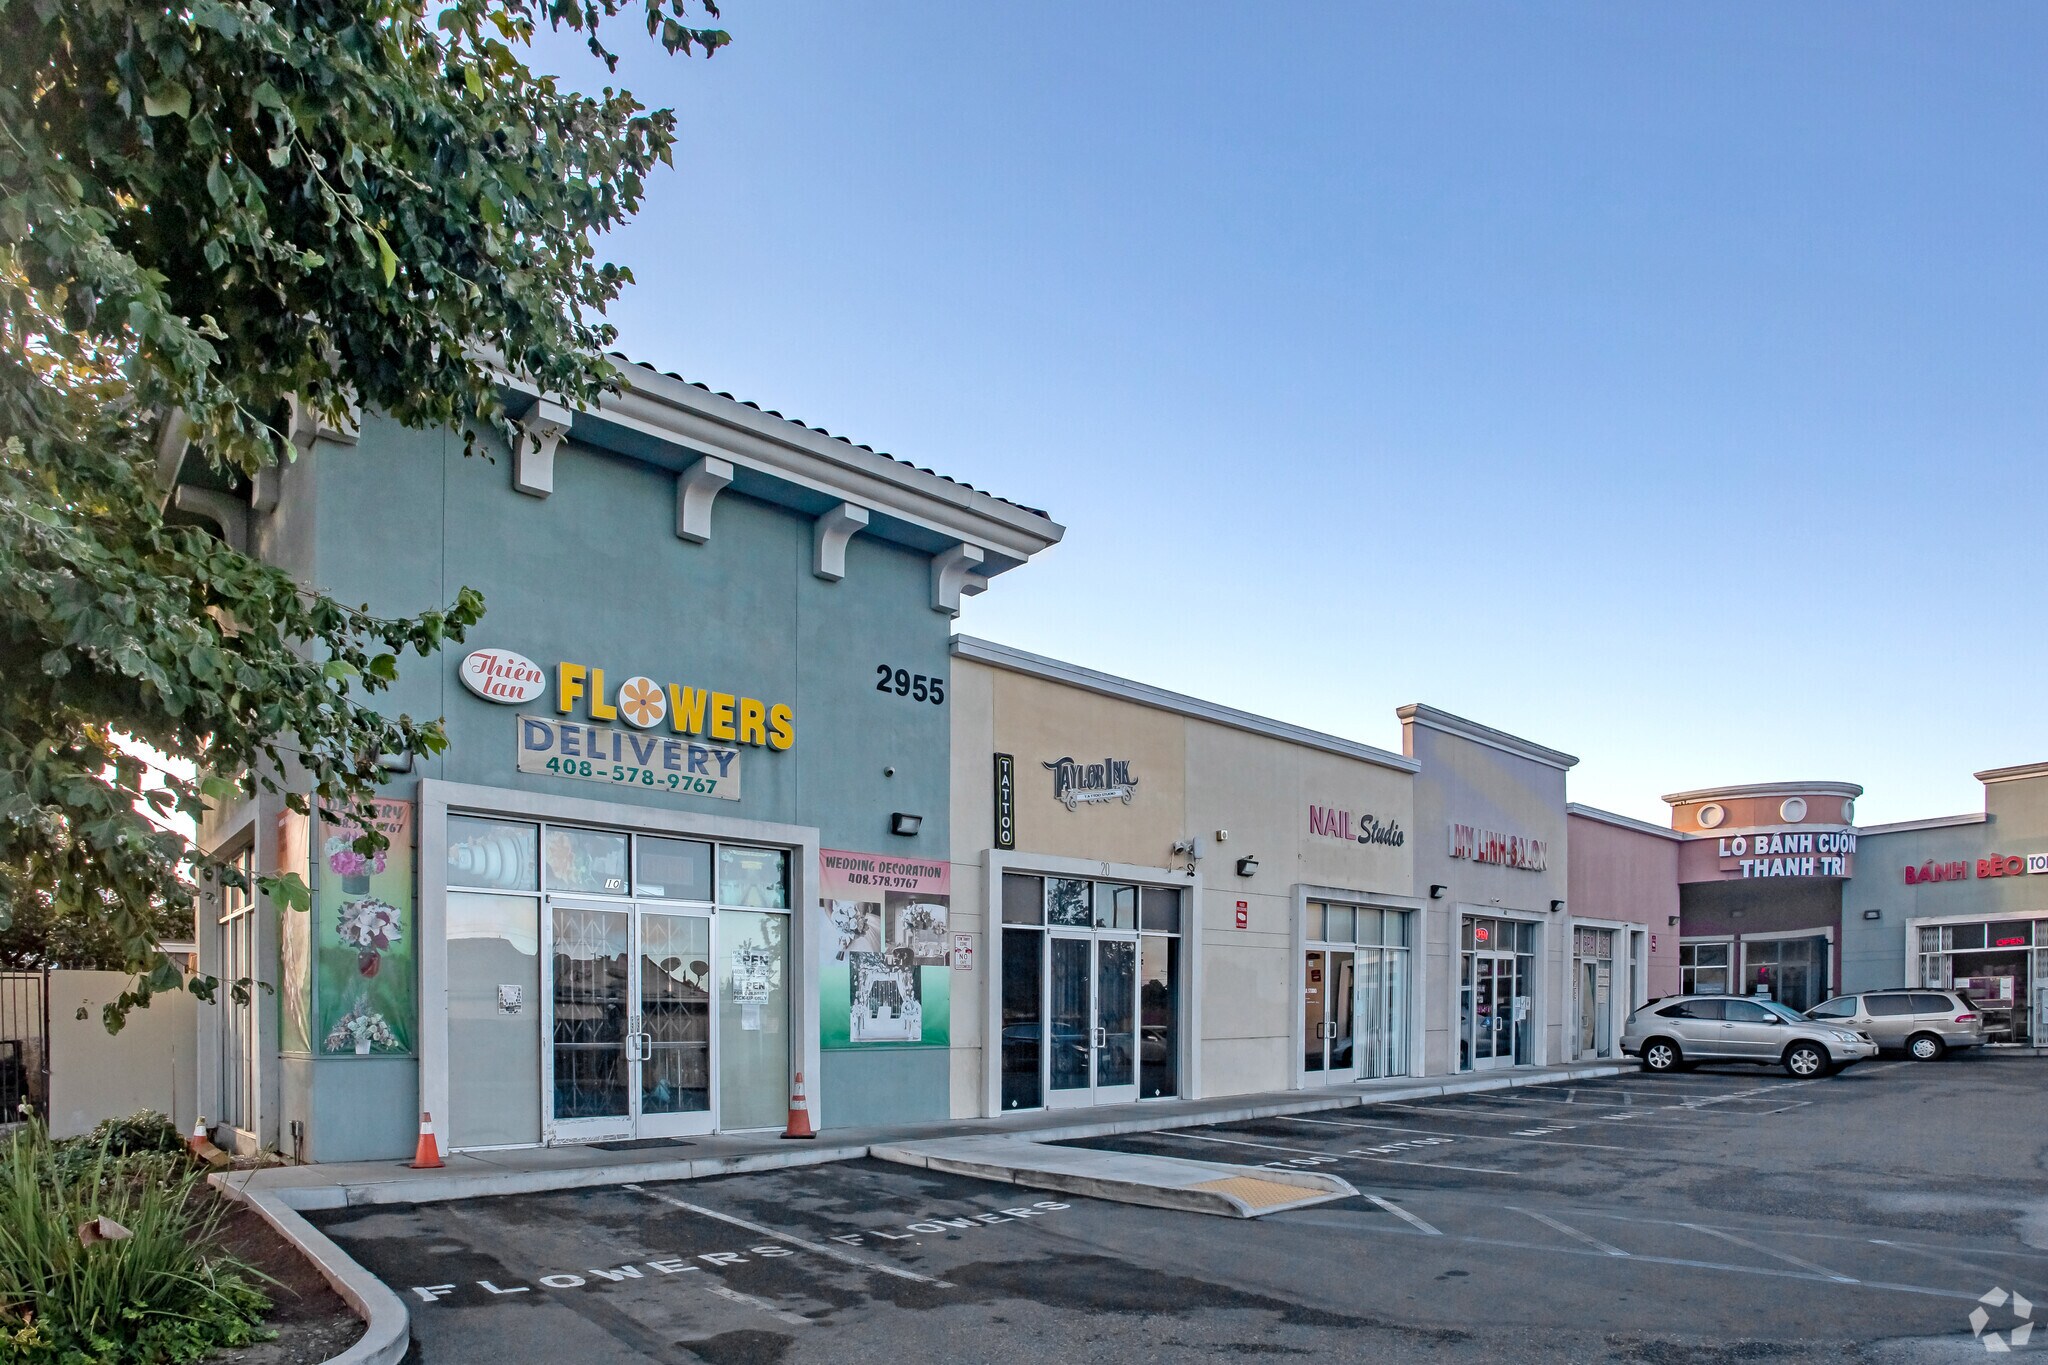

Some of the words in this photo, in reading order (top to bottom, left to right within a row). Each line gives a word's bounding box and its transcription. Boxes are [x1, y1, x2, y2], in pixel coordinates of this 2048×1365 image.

[469, 652, 543, 684] Thiên
[876, 664, 945, 705] 2955
[524, 719, 738, 777] DELIVERY
[546, 756, 718, 794] 408-578-9767
[1042, 756, 1105, 798] TAYLOR
[1001, 760, 1011, 843] TATTOO
[1310, 805, 1356, 840] NAIL
[1358, 814, 1404, 847] Studio
[1719, 834, 1747, 857] LÒ
[1755, 832, 1813, 855] BÁNH
[826, 857, 875, 872] WEDDING
[879, 862, 941, 878] DECORATION
[1101, 861, 1110, 876] 20
[1740, 857, 1814, 878] THANH
[1821, 853, 1846, 876] TRÌ
[1904, 859, 1967, 884] BÁNH
[1976, 852, 2024, 878] BÈO
[2029, 856, 2048, 870] TO
[608, 880, 619, 888] 10
[848, 873, 918, 888] 408.578.9767
[1996, 937, 2024, 946] OPEN
[830, 1201, 1071, 1247] FLOWERS
[411, 1245, 794, 1302] FLOWERS
